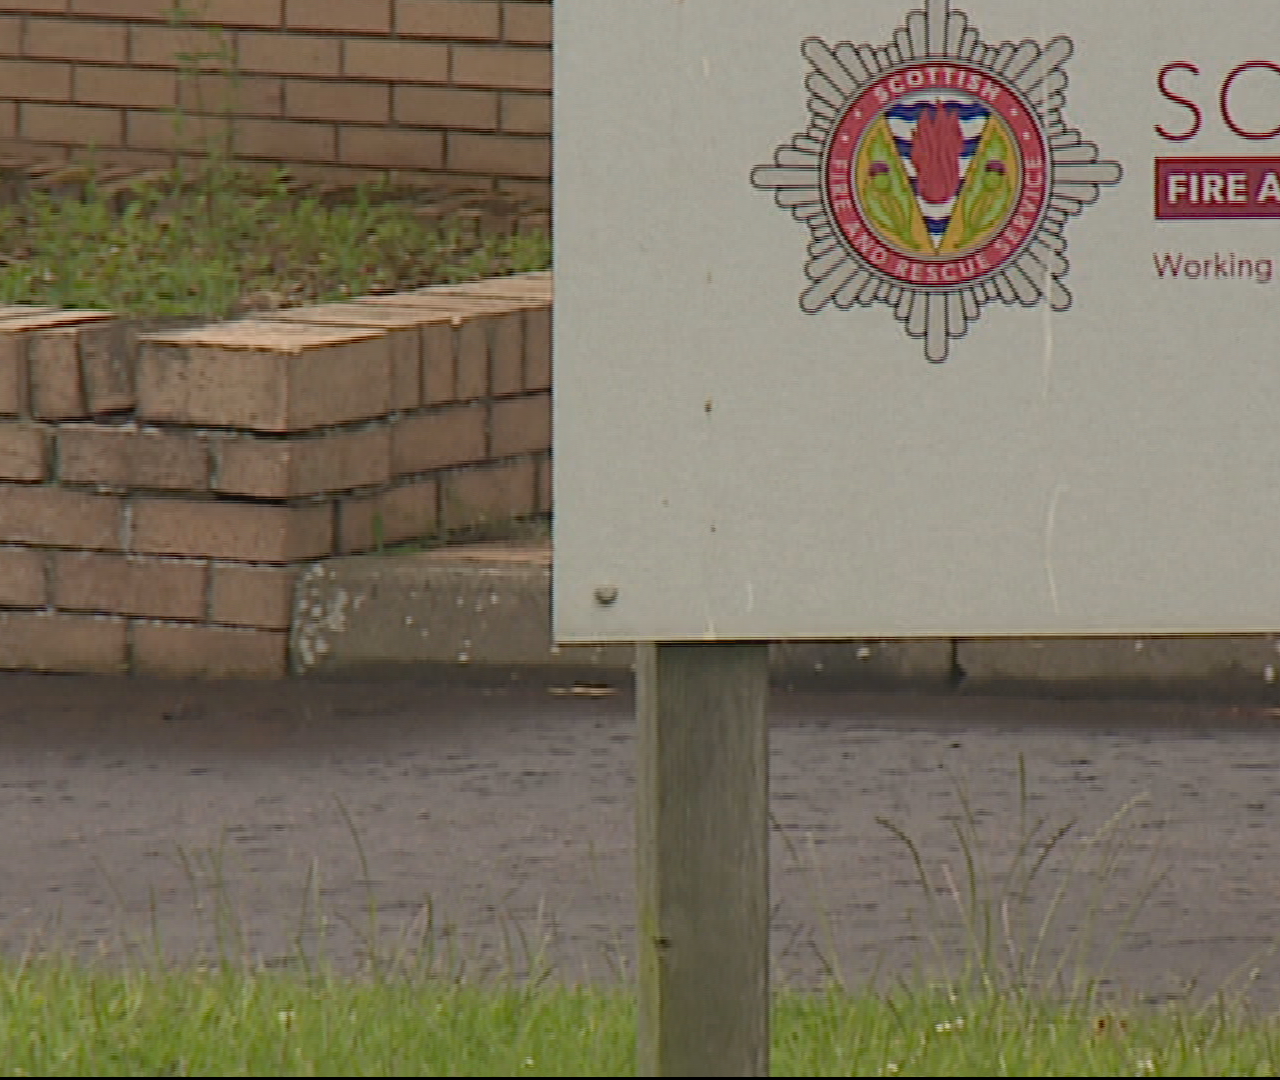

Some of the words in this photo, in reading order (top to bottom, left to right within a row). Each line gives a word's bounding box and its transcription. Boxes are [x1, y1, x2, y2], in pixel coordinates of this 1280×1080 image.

[874, 67, 1001, 102] SCOTTISH
[1167, 172, 1248, 204] FIRE
[829, 158, 852, 209] FIRE
[845, 222, 888, 266] AND
[895, 253, 990, 282] RESCUE
[994, 156, 1043, 252] SERVICE
[1152, 251, 1272, 284] Working
